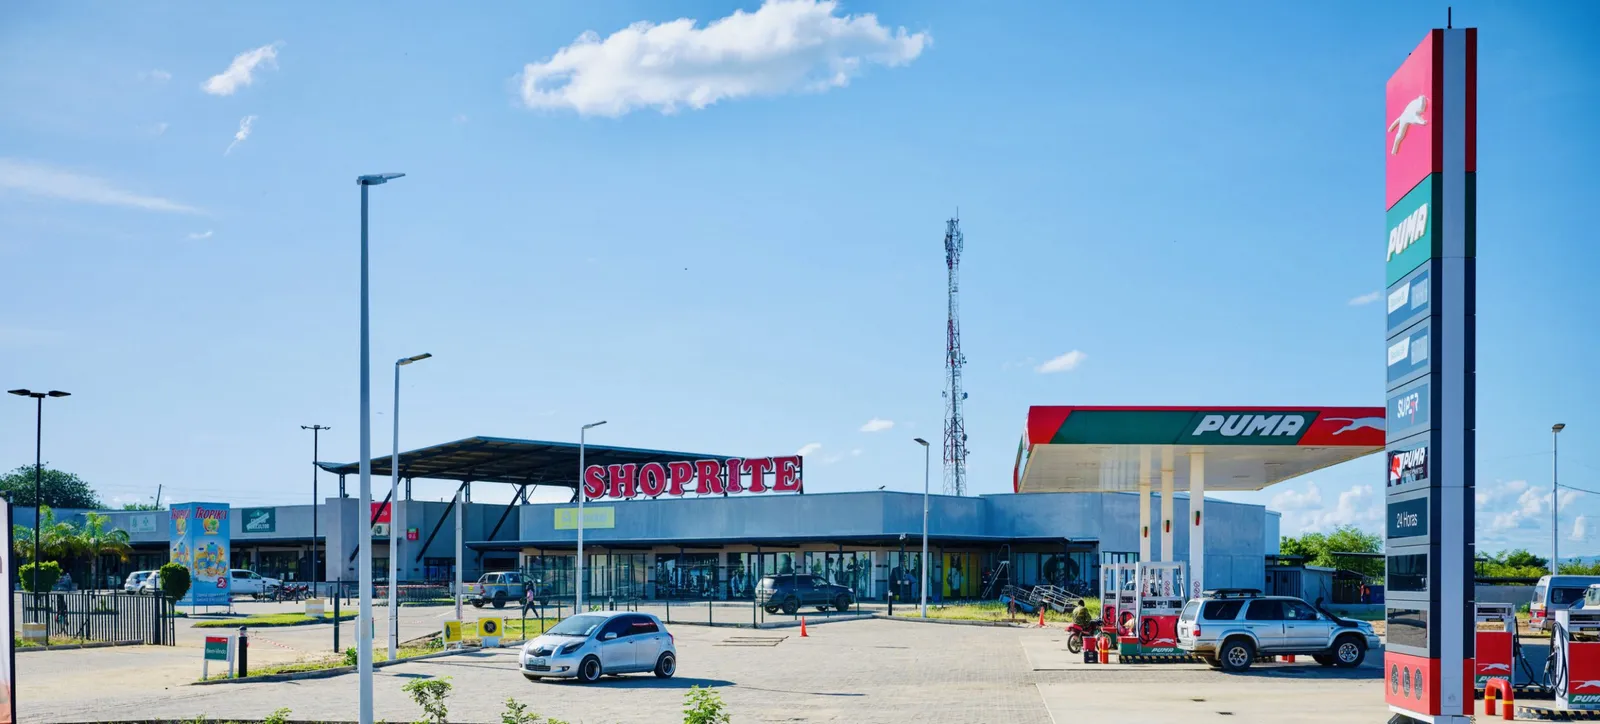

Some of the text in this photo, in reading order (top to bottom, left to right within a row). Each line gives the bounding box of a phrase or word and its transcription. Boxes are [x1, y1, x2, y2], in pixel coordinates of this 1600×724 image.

[1386, 202, 1428, 262] PUMA
[1191, 414, 1305, 436] PUMA
[1402, 447, 1425, 469] PUMA
[583, 455, 801, 499] SHOPRITE
[195, 506, 227, 519] TROPIKA
[1396, 511, 1417, 528] 24 Horas
